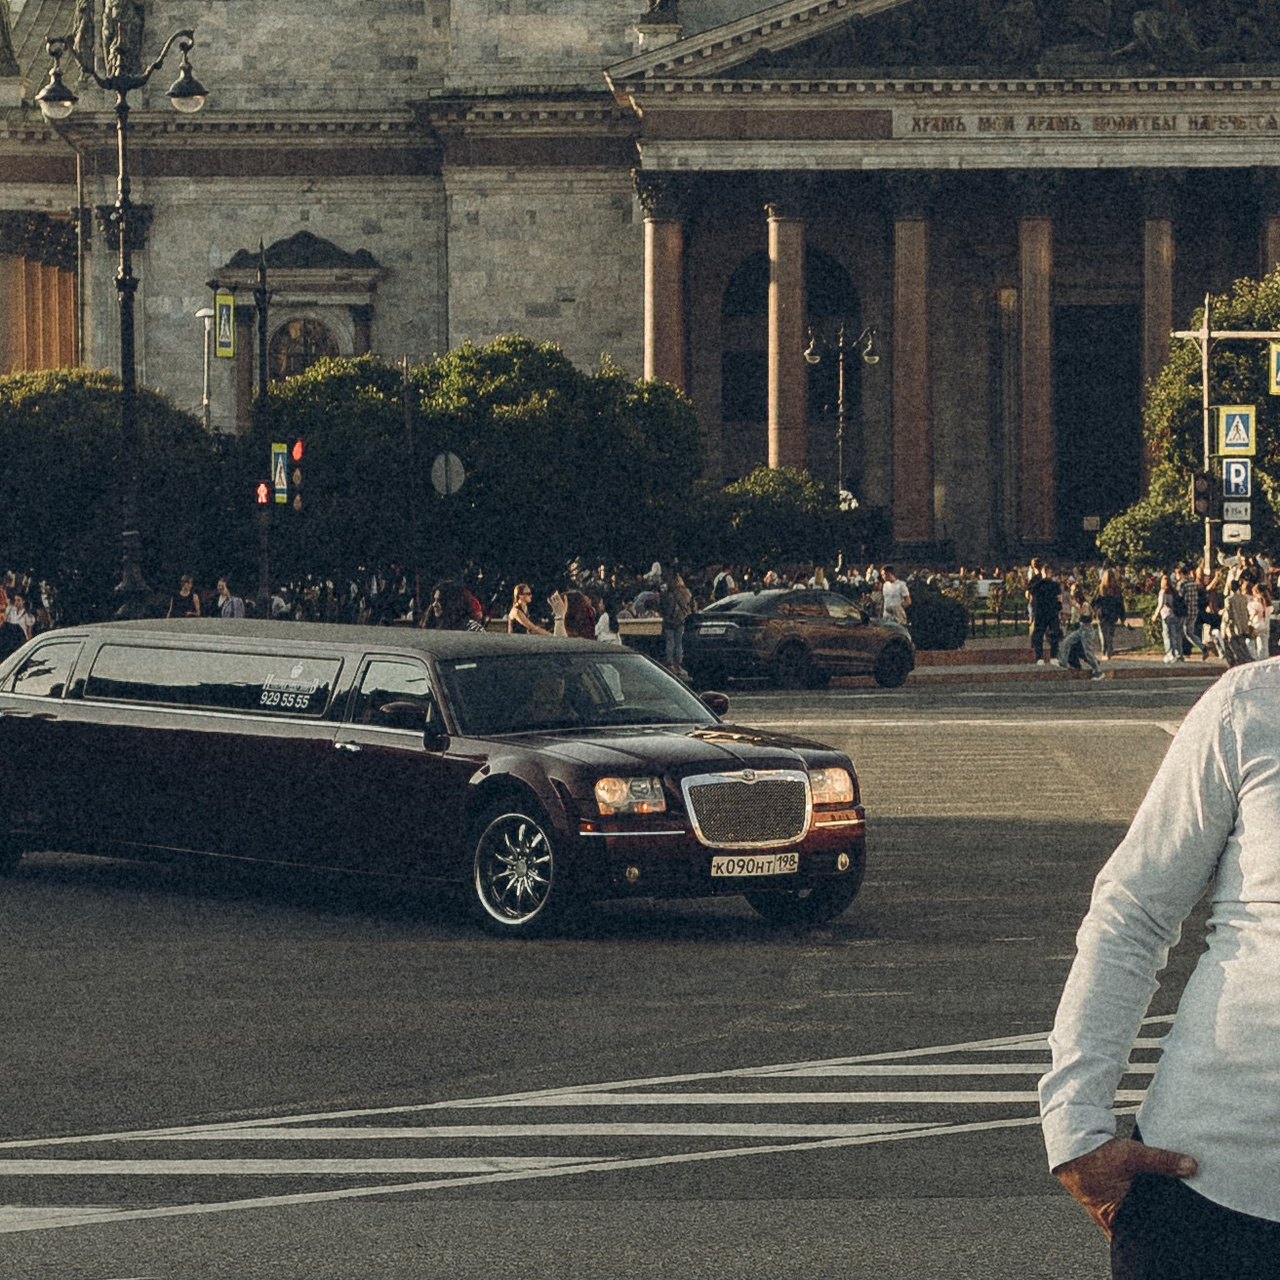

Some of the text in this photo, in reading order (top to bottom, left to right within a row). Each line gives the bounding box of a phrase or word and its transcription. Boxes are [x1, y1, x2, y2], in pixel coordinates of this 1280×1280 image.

[260, 691, 310, 709] 929 55 55
[716, 854, 797, 874] К090НТ 198
